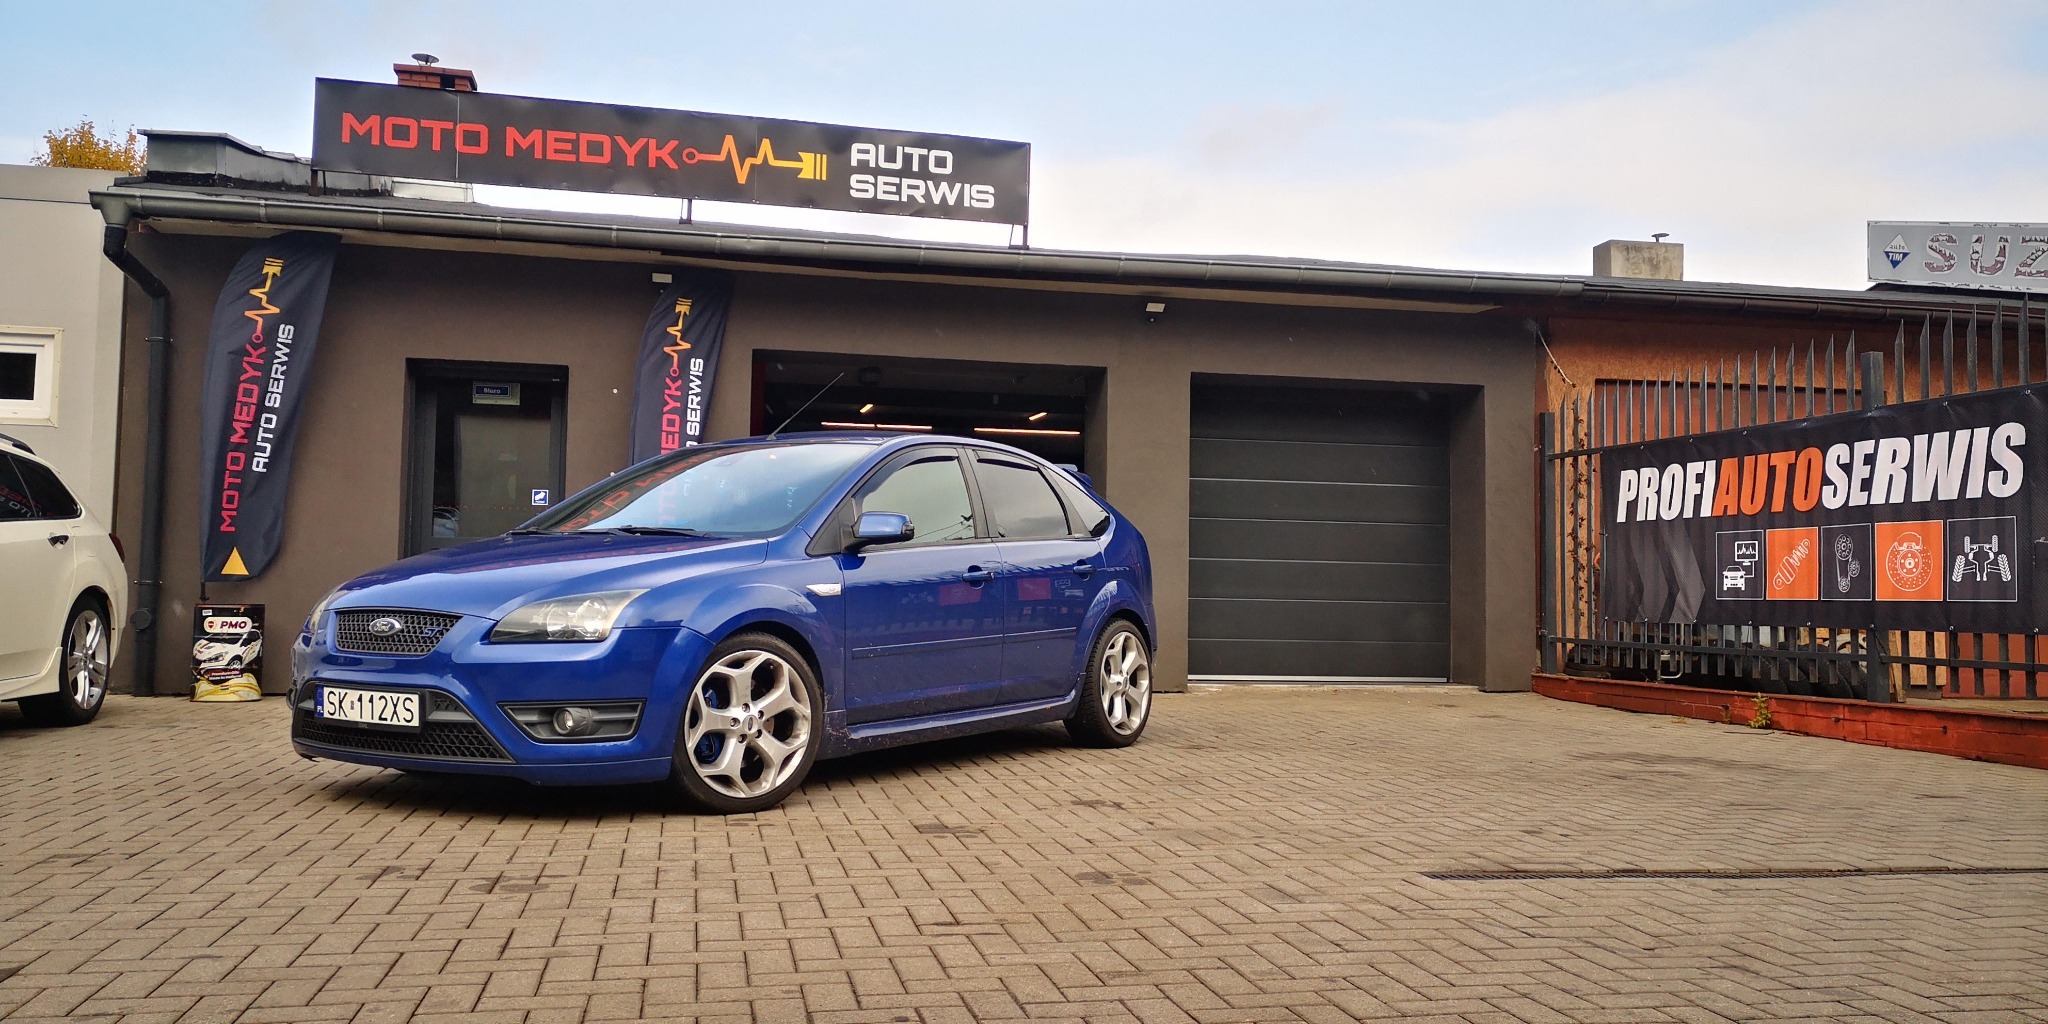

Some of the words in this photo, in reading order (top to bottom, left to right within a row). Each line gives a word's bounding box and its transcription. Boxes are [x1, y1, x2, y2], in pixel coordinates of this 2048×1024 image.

[341, 112, 490, 156] MOTO
[505, 125, 680, 171] MEDYK
[850, 142, 954, 175] AUTO
[849, 173, 996, 209] SERWIS
[1888, 252, 1904, 262] TIM
[229, 344, 267, 444] MEDYK
[264, 323, 295, 408] SERWIS
[686, 357, 704, 436] SERWIS
[251, 412, 278, 473] AUTO
[660, 377, 682, 455] EDYK
[220, 451, 246, 532] MOTO
[1616, 422, 2026, 523] PROFIAUTOSERWIS
[219, 620, 247, 629] PMO
